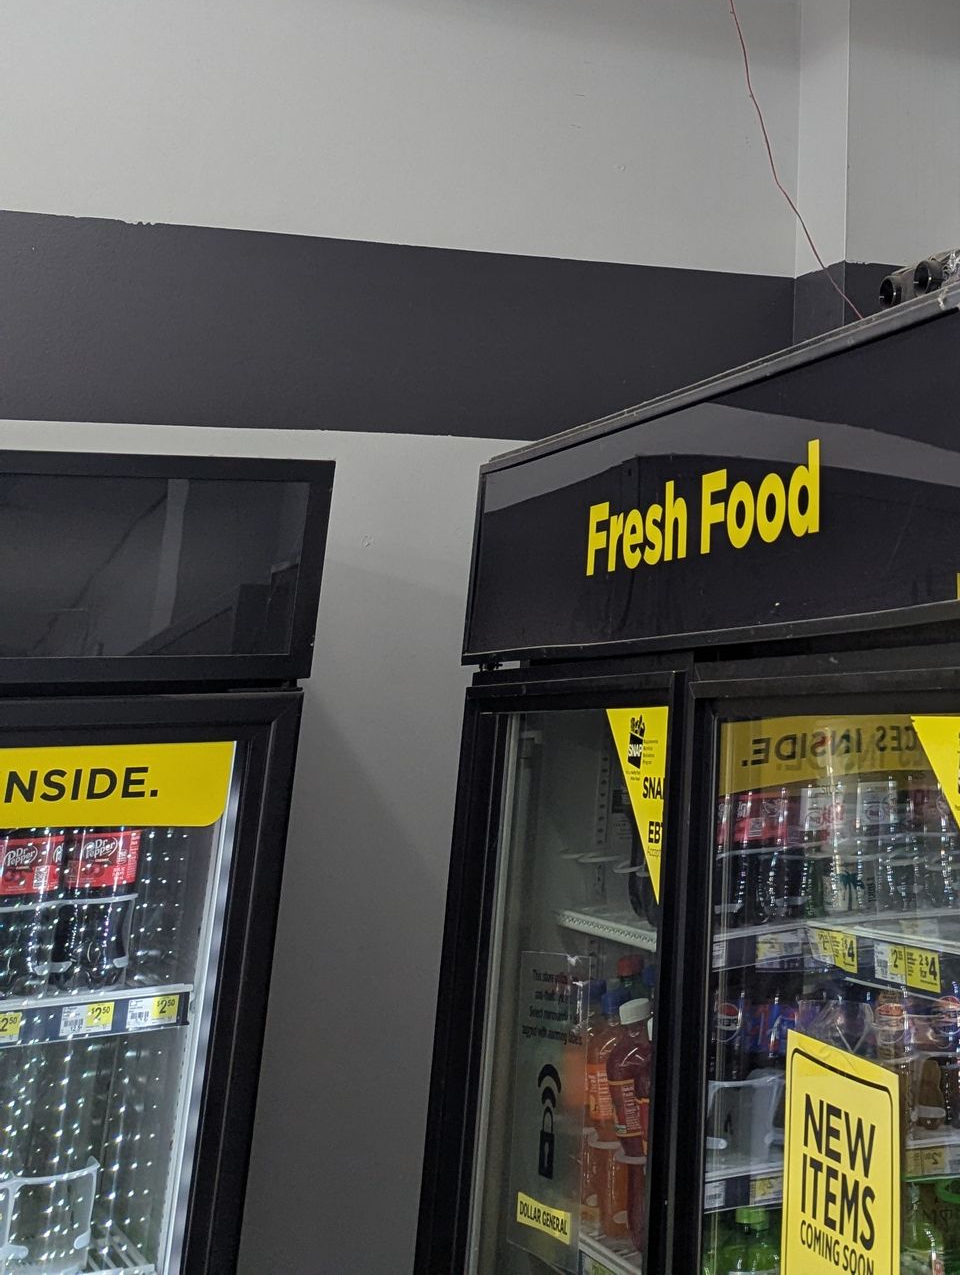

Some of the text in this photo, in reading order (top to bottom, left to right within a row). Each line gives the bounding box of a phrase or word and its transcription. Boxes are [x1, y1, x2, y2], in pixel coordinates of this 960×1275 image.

[586, 439, 820, 576] Fresh Food
[95, 838, 108, 849] Dr
[648, 821, 663, 844] EB
[4, 850, 36, 867] Pepper
[16, 847, 28, 857] Dr
[84, 841, 116, 859] Pepper
[803, 1093, 876, 1179] NEW
[801, 1153, 876, 1251] ITEMS
[519, 1201, 568, 1236] DOLLAR GENERAL
[800, 1219, 875, 1275] COMING SOON
